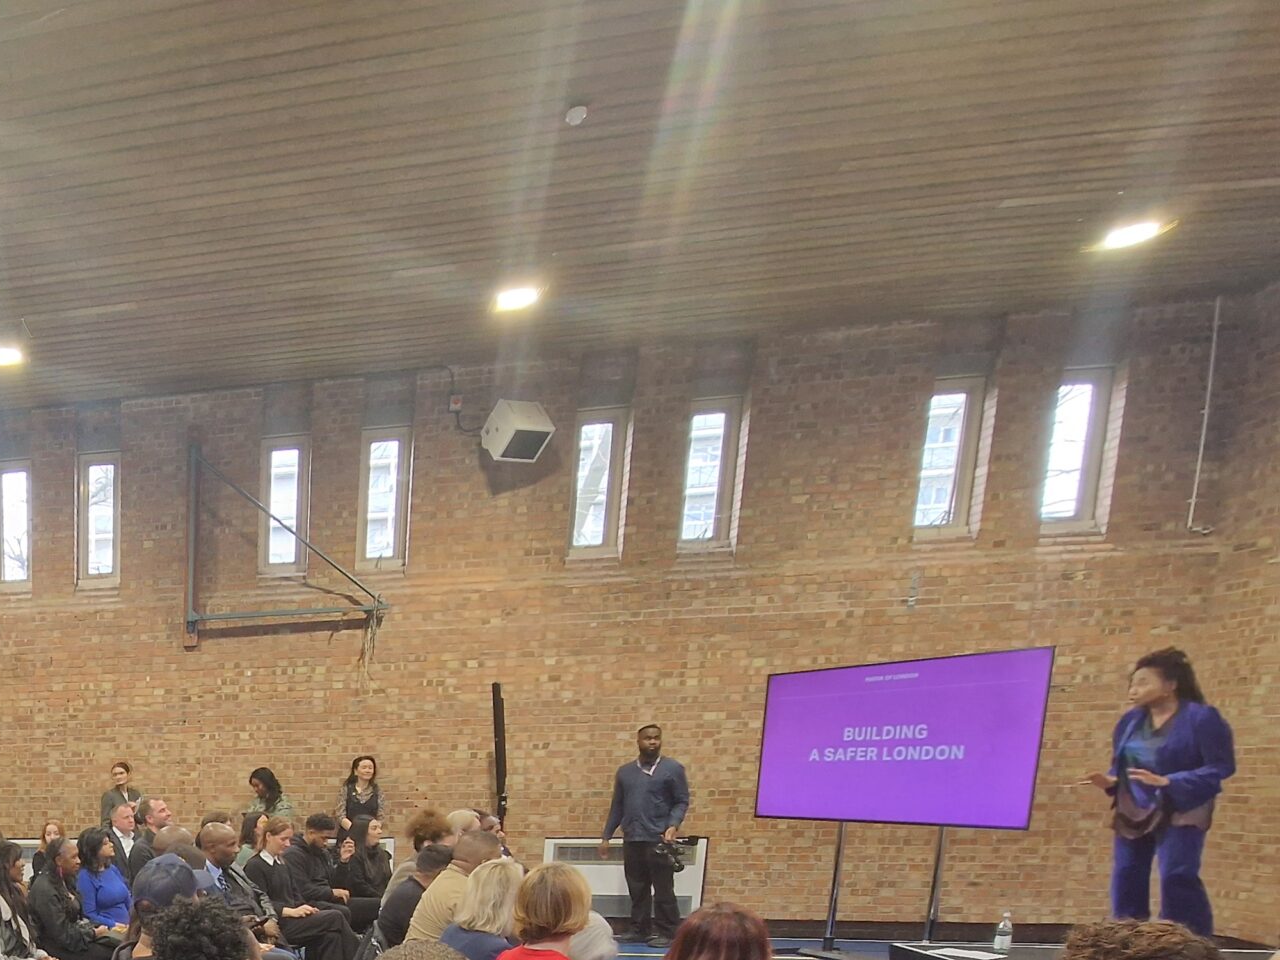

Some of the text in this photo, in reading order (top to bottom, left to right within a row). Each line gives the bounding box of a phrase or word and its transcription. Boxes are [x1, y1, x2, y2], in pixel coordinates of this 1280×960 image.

[843, 724, 928, 741] BUILDING
[809, 745, 965, 762] A SAFER LONDON
